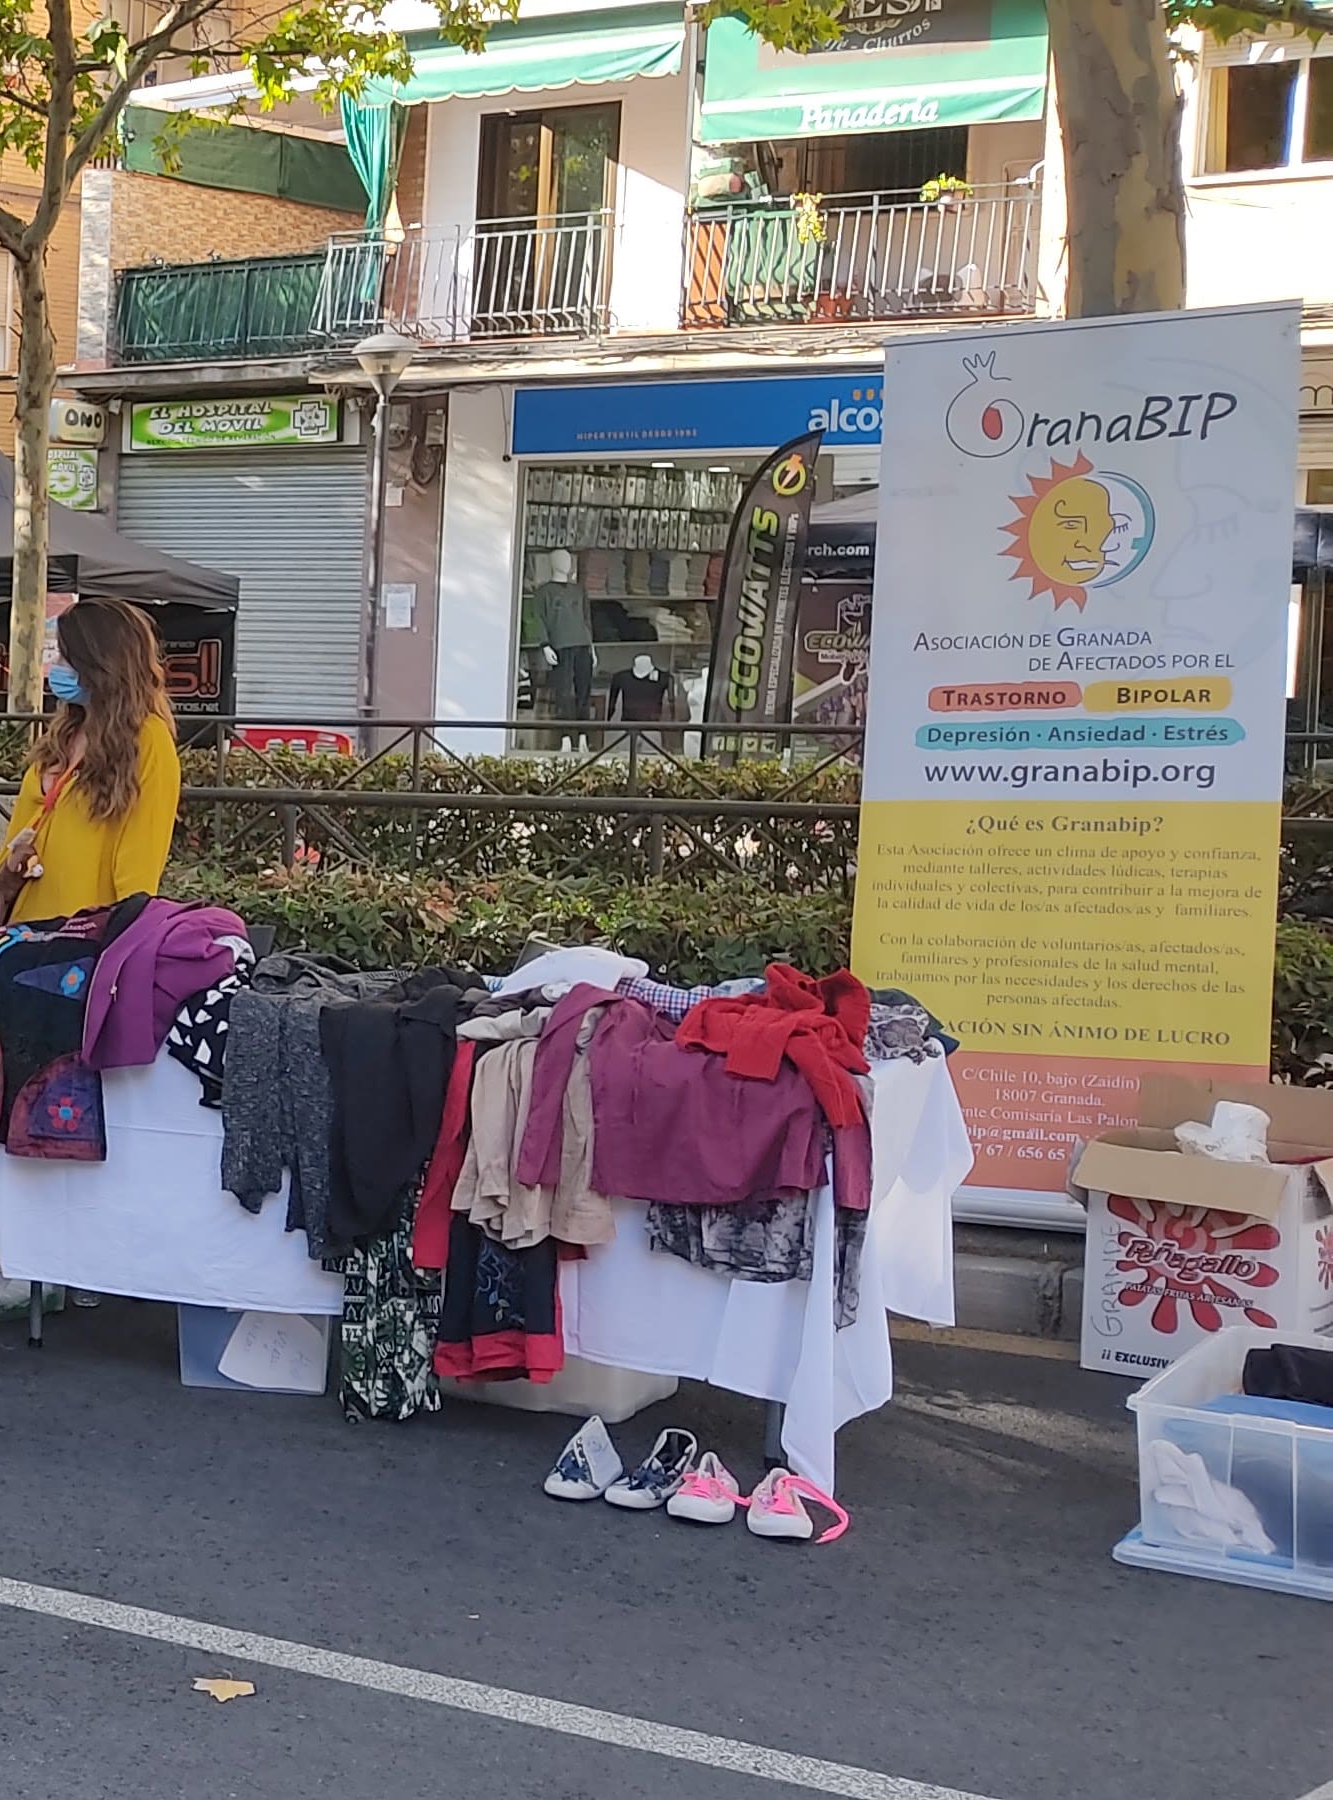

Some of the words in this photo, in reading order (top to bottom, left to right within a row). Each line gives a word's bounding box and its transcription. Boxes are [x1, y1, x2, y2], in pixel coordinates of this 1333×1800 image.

[863, 18, 931, 54] Churros
[64, 408, 102, 429] ONO
[148, 406, 169, 420] EL
[177, 401, 272, 419] HOSPITAL
[159, 420, 194, 435] DEL
[808, 544, 870, 557] rch.com
[727, 505, 780, 713] ECOWATTS
[913, 631, 1024, 652] ASOCIACIÓN
[1029, 633, 1052, 648] DE
[1057, 626, 1152, 647] GRANADA
[1029, 656, 1051, 671] DE
[1056, 650, 1167, 672] AFECTADOS
[1171, 654, 1209, 668] POR
[1214, 653, 1235, 667] EL
[942, 688, 1067, 706] TRASTORNO
[1116, 685, 1212, 704] BIPOLAR
[927, 725, 1030, 745] Depresión
[1047, 723, 1146, 743] Ansiedad
[1164, 723, 1228, 742] Estrés
[923, 757, 1216, 789] www.granabip.org
[965, 815, 1019, 836] ¿Qué
[1025, 819, 1045, 832] es
[1051, 815, 1164, 837] Granabip?
[877, 843, 904, 856] Esta
[909, 843, 984, 857] Asociación
[988, 844, 1031, 858] ofrece
[1035, 847, 1053, 858] un
[1057, 846, 1096, 859] clima
[1101, 846, 1117, 859] de
[1122, 849, 1166, 863] apoyo
[1170, 849, 1179, 863] y
[1184, 847, 1262, 862] confianza,
[903, 861, 964, 875] mediante
[969, 862, 1022, 877] talleres,
[1026, 863, 1107, 878] actividades
[1111, 864, 1166, 879] lúdicas,
[1171, 865, 1229, 881] terapias
[872, 879, 953, 893] individuales
[957, 883, 966, 896] y
[970, 881, 1043, 895] colectivas,
[1047, 884, 1078, 898] para
[1083, 883, 1152, 897] contribuir
[1157, 887, 1166, 897] a
[1170, 884, 1183, 898] la
[1188, 885, 1240, 901] mejora
[1244, 885, 1262, 899] de
[877, 897, 889, 910] la
[892, 897, 941, 911] calidad
[945, 897, 962, 911] de
[966, 898, 995, 912] vida
[999, 899, 1016, 912] de
[1155, 905, 1165, 918] y
[1175, 903, 1253, 918] familiares.
[879, 932, 908, 946] Con
[912, 933, 923, 946] la
[927, 934, 1016, 949] colaboración
[1020, 936, 1037, 950] de
[901, 952, 969, 966] familiares
[972, 955, 982, 968] y
[985, 954, 1079, 971] profesionales
[1083, 957, 1100, 971] de
[1105, 957, 1117, 971] la
[1121, 958, 1160, 972] salud
[1164, 961, 1219, 975] mental,
[876, 970, 951, 984] trabajamos
[953, 973, 978, 987] por
[982, 972, 1001, 985] las
[1004, 974, 1089, 989] necesidades
[1093, 979, 1103, 992] y
[1107, 976, 1128, 990] los
[1131, 978, 1197, 993] derechos
[1201, 980, 1220, 993] de
[1225, 980, 1245, 994] las
[986, 992, 1048, 1007] personas
[1051, 994, 1123, 1009] afectadas.
[1011, 1023, 1043, 1036] SIN
[1048, 1020, 1118, 1041] ÁNIMO
[1124, 1028, 1150, 1042] DE
[1157, 1029, 1231, 1046] LUCRO
[961, 1067, 1017, 1083] C/Chile
[1020, 1071, 1042, 1086] 10,
[1046, 1072, 1078, 1089] bajo
[1081, 1073, 1141, 1091] (Zaidín)
[994, 1087, 1037, 1101] 18007
[1041, 1091, 1106, 1107] Granada.
[990, 1106, 1062, 1123] Comisaría
[1067, 1111, 1093, 1124] Las
[985, 1144, 1004, 1157] 67
[1016, 1146, 1044, 1160] 656
[1047, 1148, 1066, 1161] 65
[1125, 1238, 1257, 1282] Peñagallo
